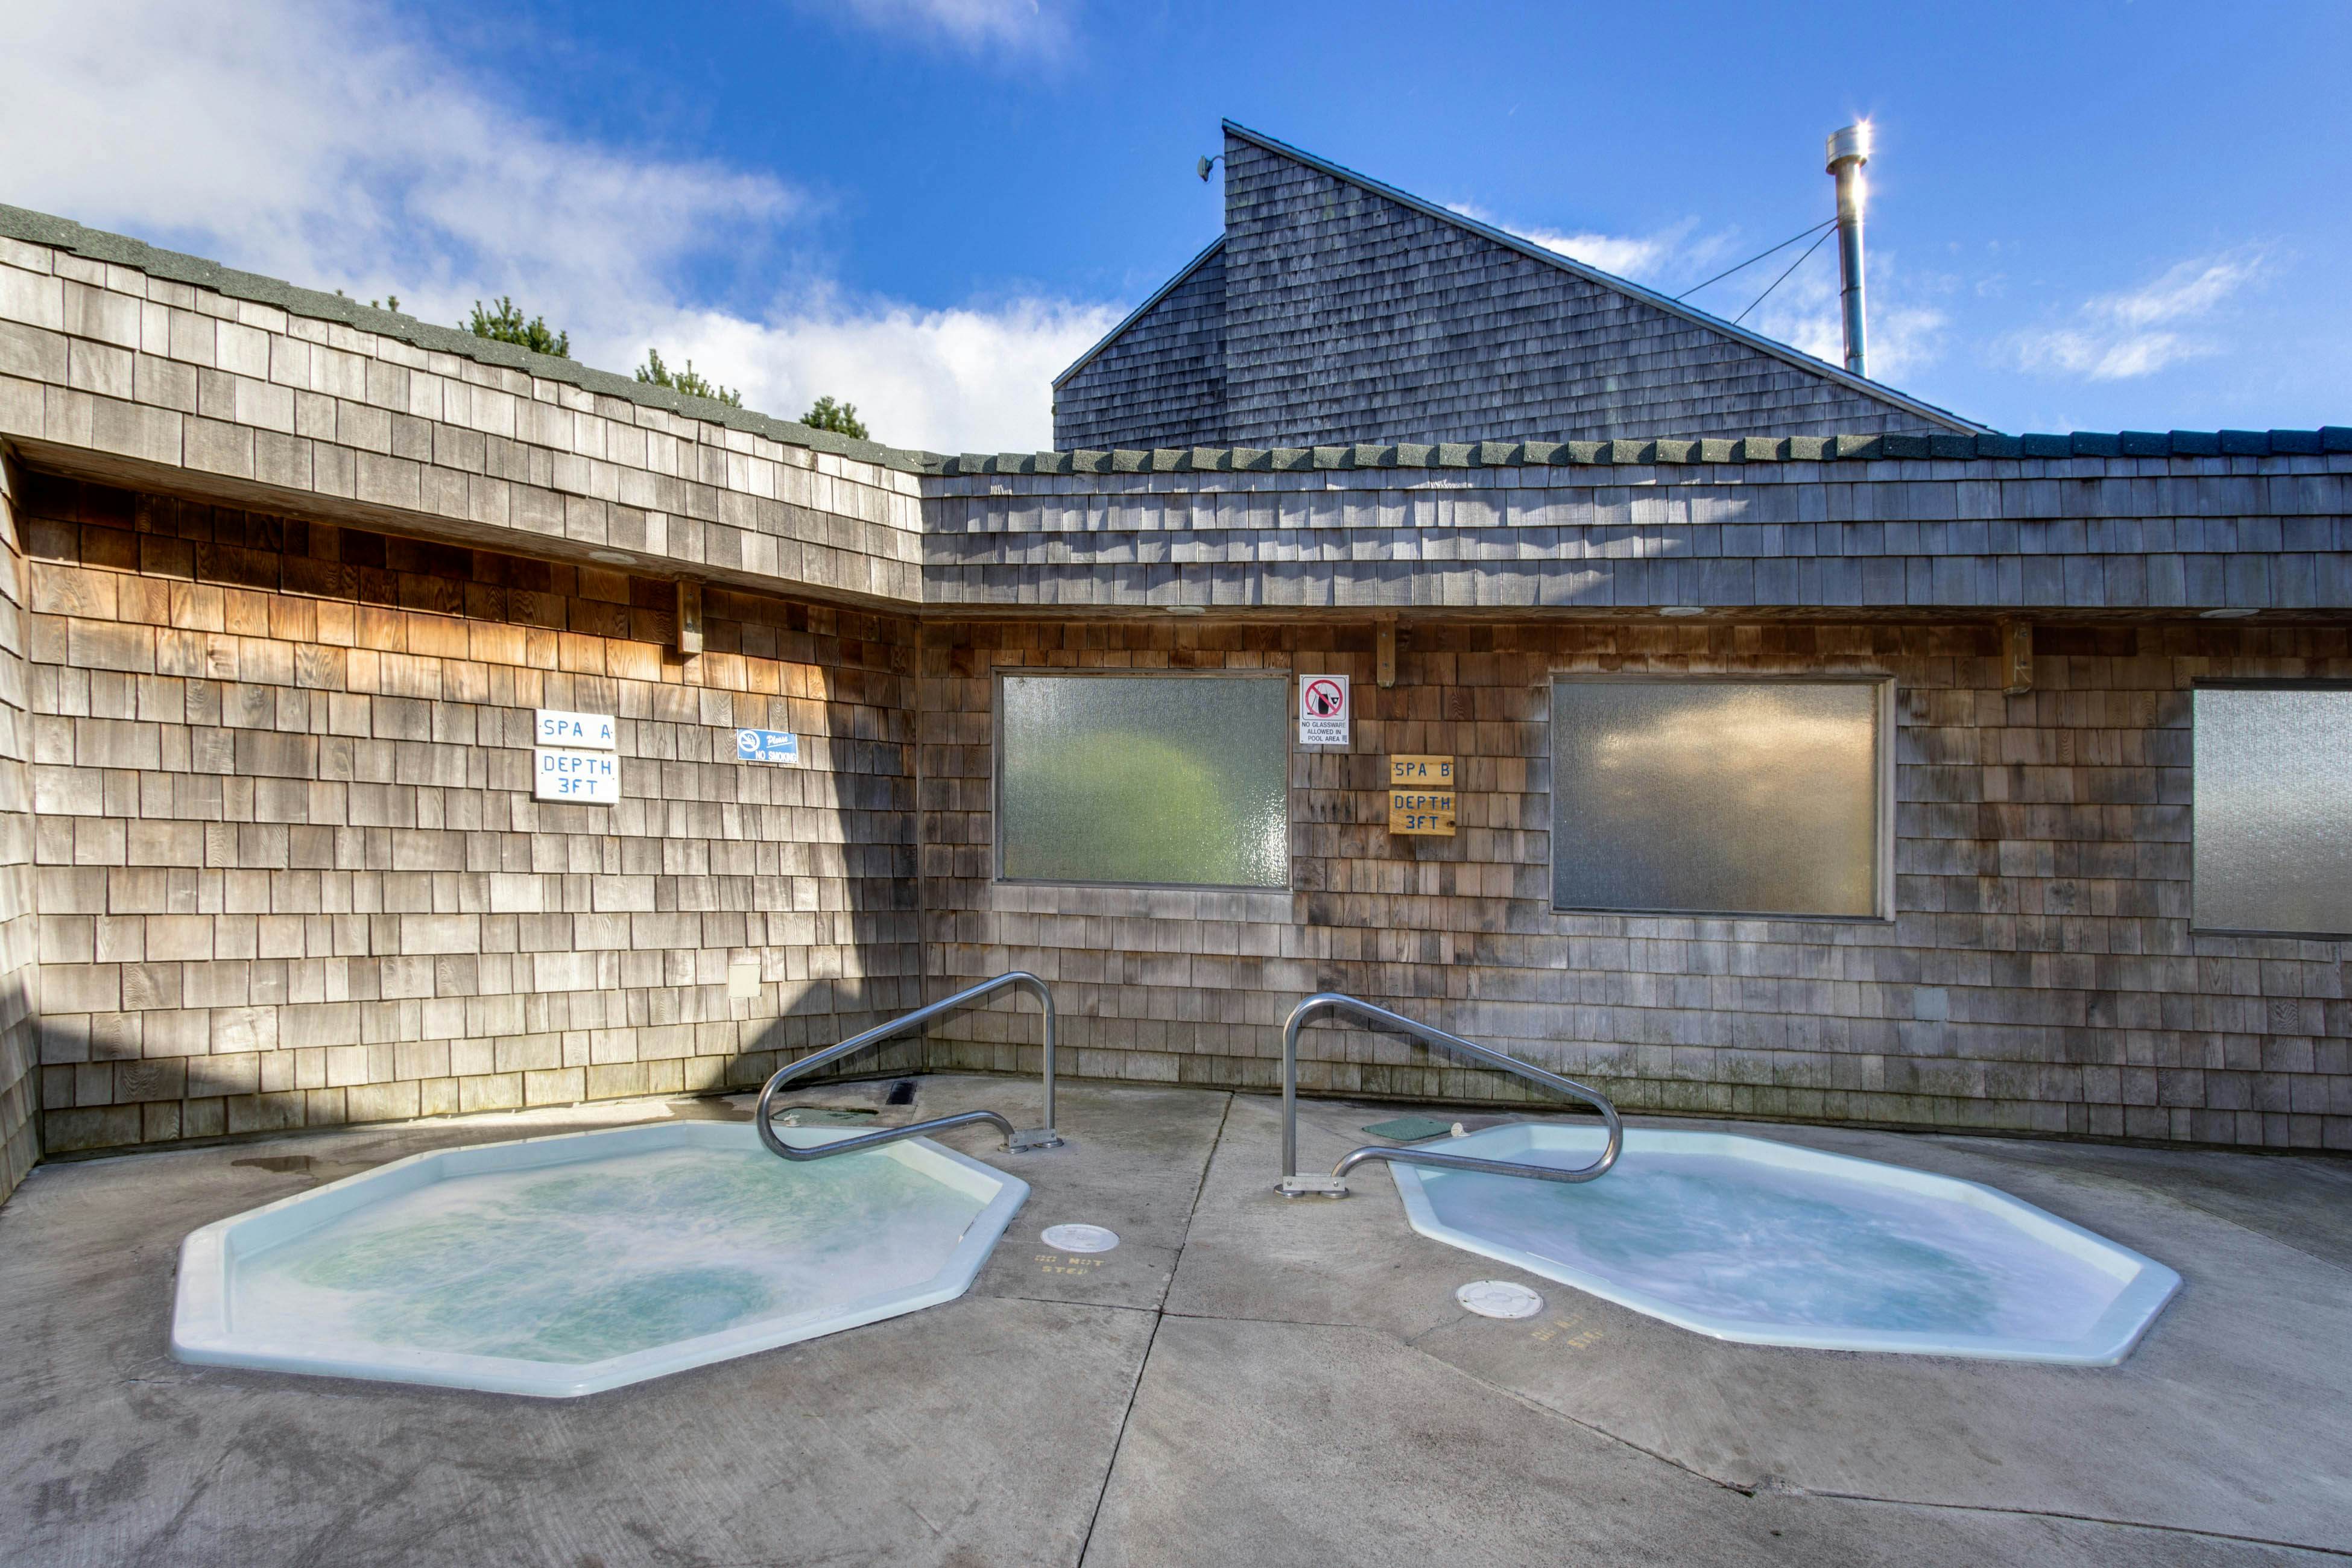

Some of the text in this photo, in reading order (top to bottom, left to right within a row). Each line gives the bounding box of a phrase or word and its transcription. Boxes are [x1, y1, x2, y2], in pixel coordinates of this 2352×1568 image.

[544, 719, 611, 739] SPA A
[767, 735, 788, 745] Please
[755, 750, 797, 762] NO SMOKING
[544, 756, 611, 775] DEPTH
[1395, 762, 1450, 777] SPA B
[558, 777, 598, 795] 3FT
[1394, 795, 1450, 811] DEPTH
[1406, 815, 1438, 830] 3FT
[1068, 1257, 1105, 1267] NOT
[1041, 1266, 1088, 1275] STEP
